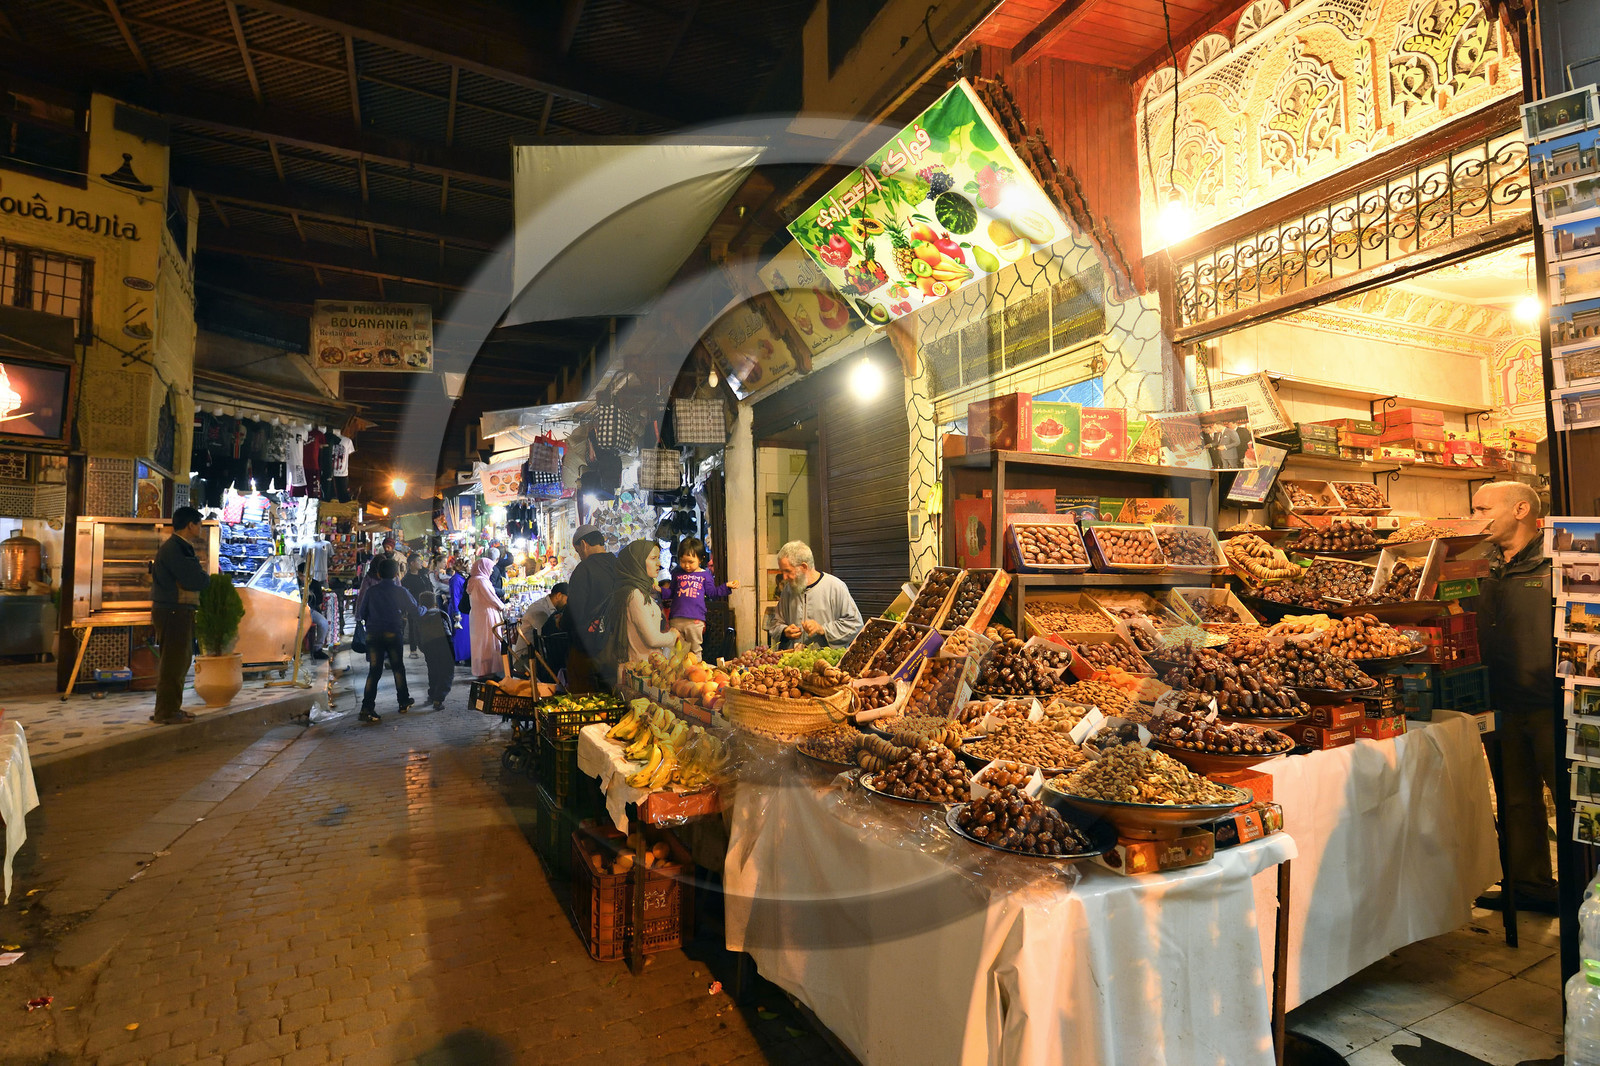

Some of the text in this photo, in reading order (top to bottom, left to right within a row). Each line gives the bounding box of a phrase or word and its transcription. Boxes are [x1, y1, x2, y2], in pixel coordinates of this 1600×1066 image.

[817, 124, 932, 230] فواكه الصحراوي
[353, 305, 414, 317] PANORAMA
[331, 317, 408, 330] BOUANANIA
[319, 329, 358, 338] Restaurant
[353, 339, 373, 347] Salon
[677, 575, 706, 583] MOMMY
[678, 587, 698, 599] ME
